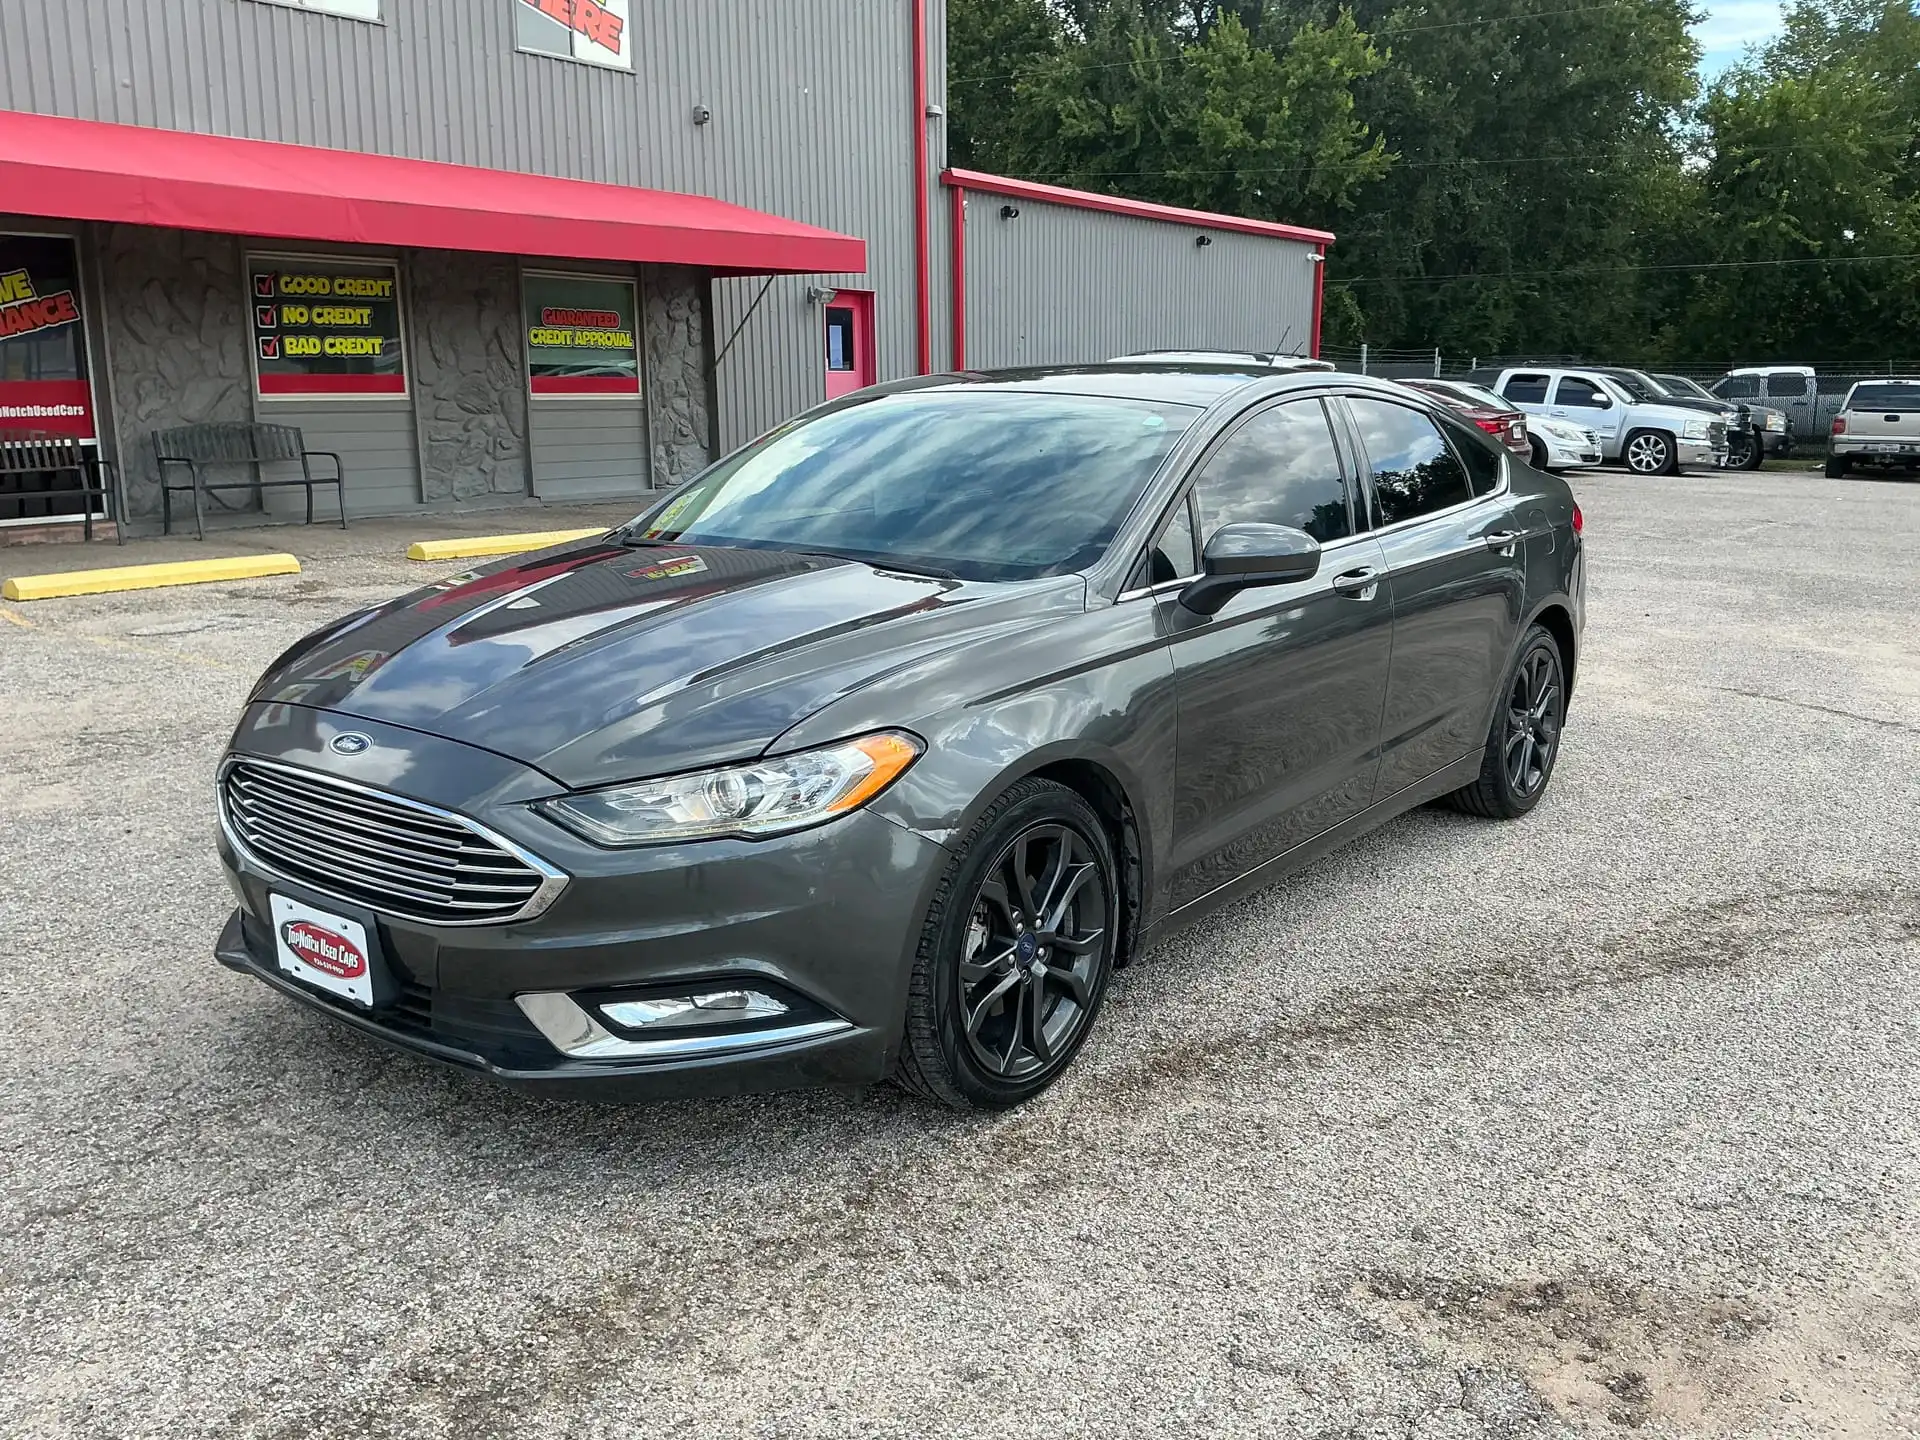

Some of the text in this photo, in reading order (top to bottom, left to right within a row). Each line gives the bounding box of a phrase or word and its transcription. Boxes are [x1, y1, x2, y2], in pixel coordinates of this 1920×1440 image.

[518, 0, 624, 55] ERE
[279, 276, 393, 297] GOOD CREDIT
[0, 293, 77, 336] ANCE
[281, 306, 371, 325] NO CREDIT
[543, 308, 619, 328] GUARANTEED
[284, 336, 383, 355] BAD CREDIT
[530, 328, 633, 347] CREDIT APPROVAL
